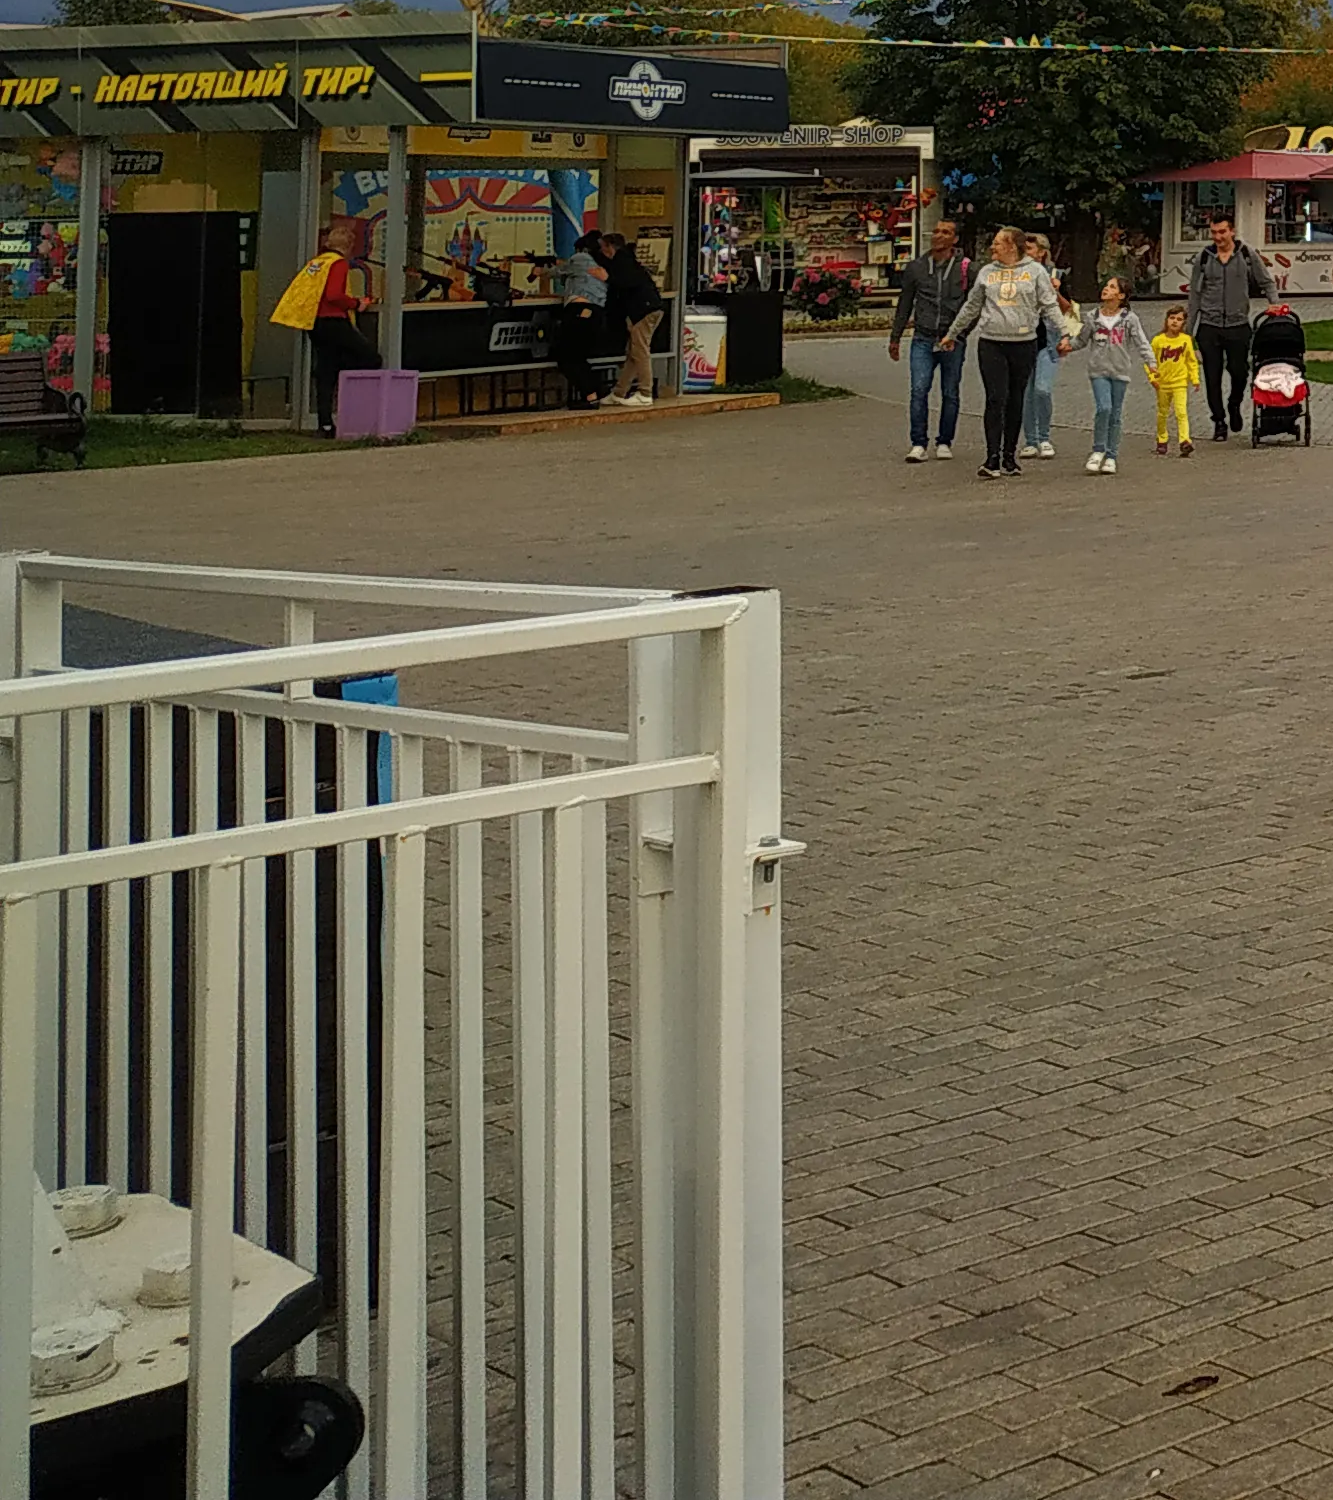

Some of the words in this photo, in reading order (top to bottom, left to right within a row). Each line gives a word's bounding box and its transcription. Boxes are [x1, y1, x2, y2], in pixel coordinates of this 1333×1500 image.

[0, 77, 60, 106] ТИР
[93, 62, 289, 104] НАСТОЯЩИЙ
[302, 65, 375, 97] ТИР!
[842, 126, 906, 145] SHOP
